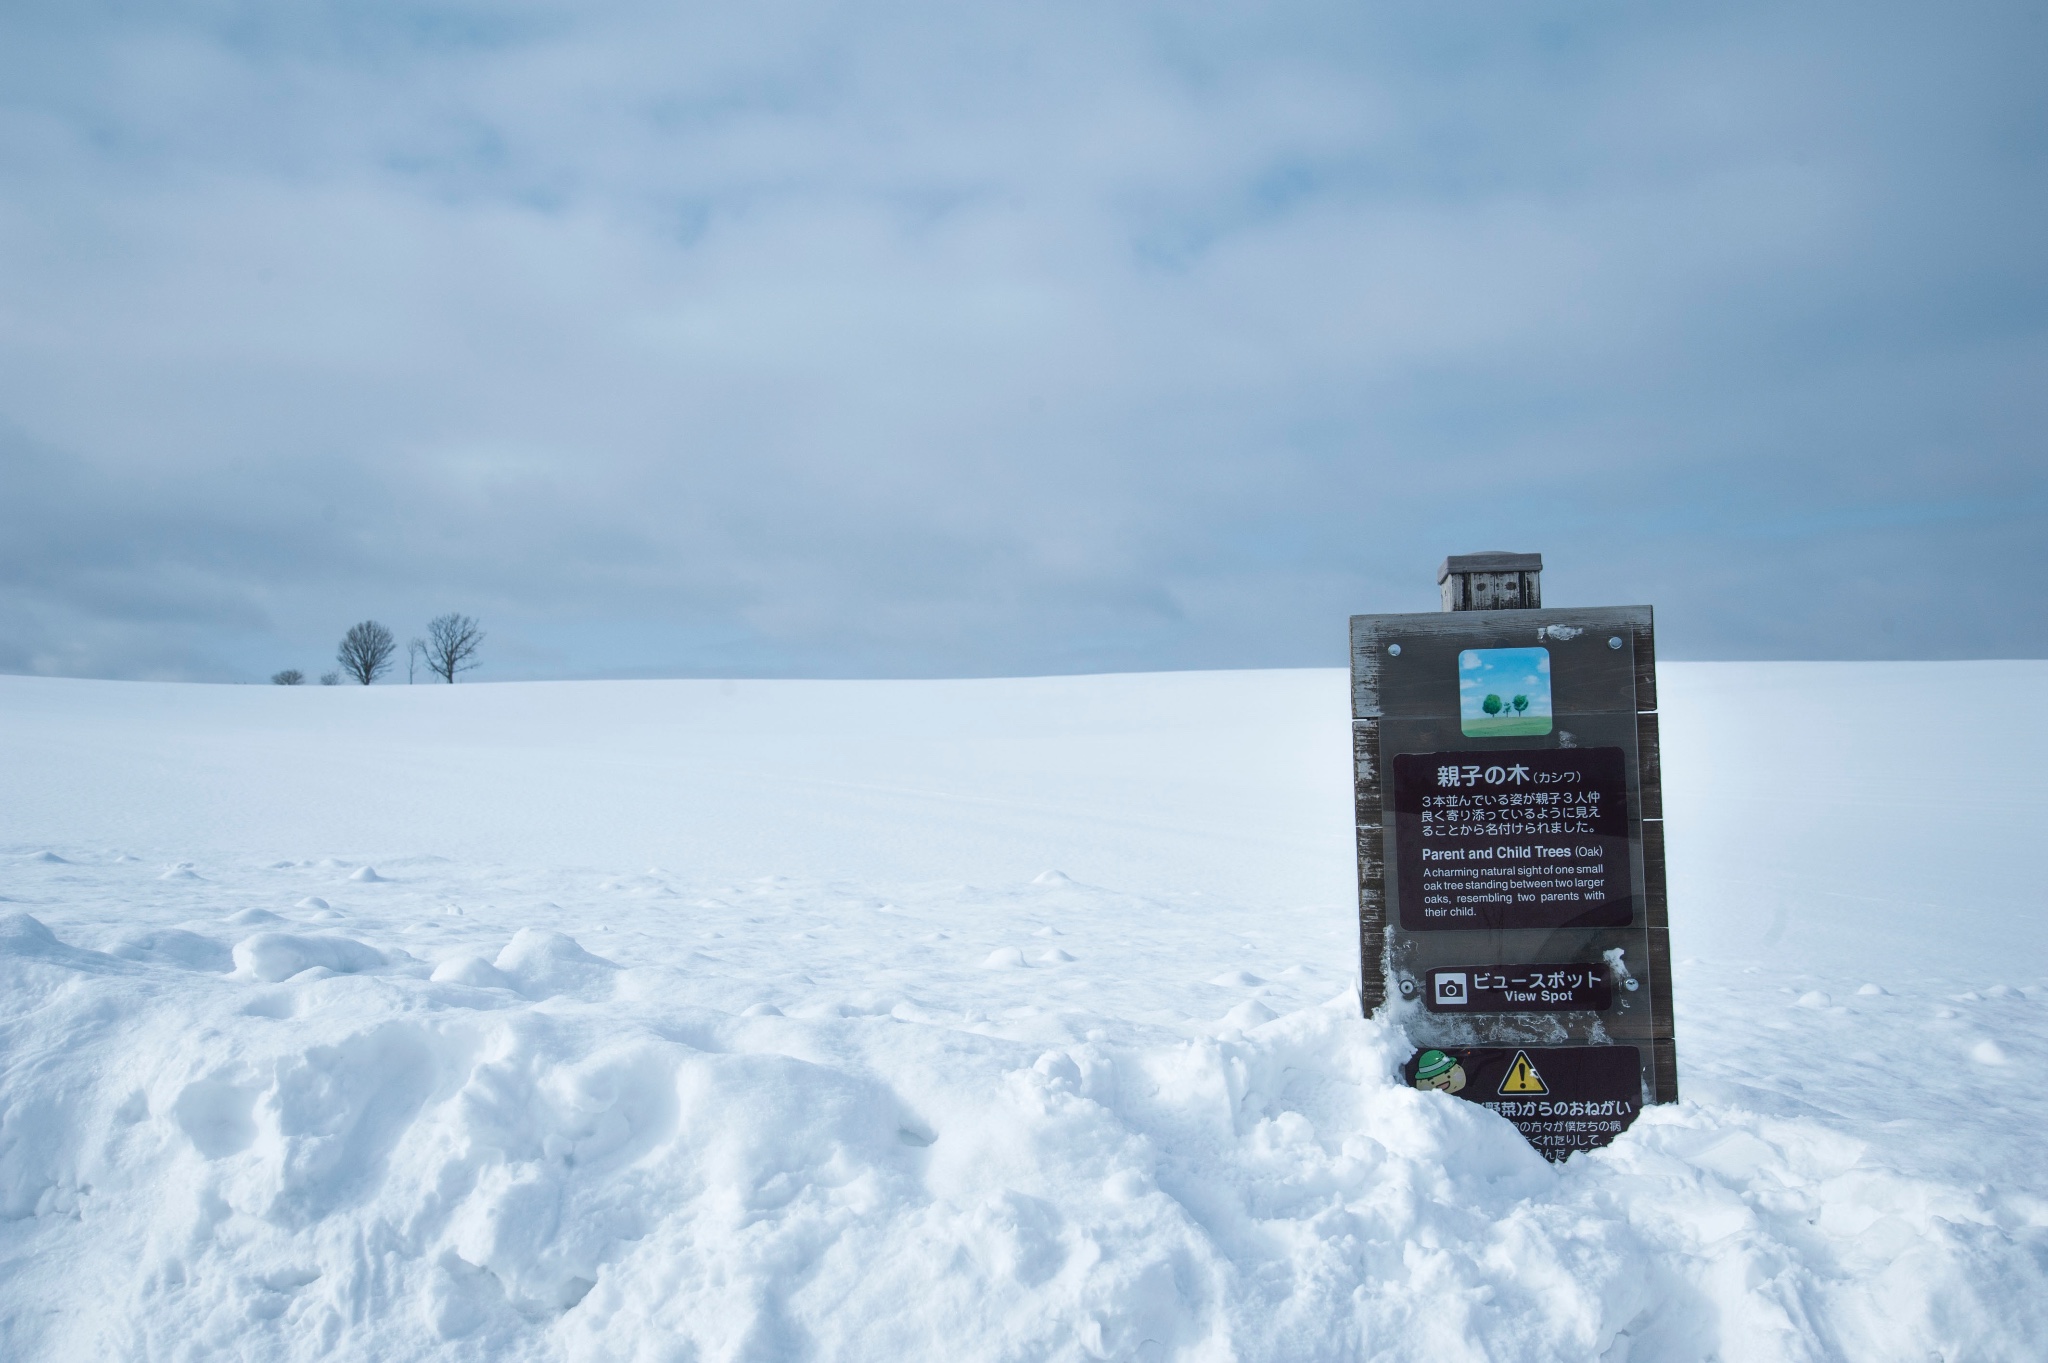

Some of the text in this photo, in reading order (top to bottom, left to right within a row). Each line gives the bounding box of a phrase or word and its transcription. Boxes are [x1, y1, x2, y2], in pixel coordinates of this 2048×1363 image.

[1437, 763, 1530, 788] 親子の木
[1421, 806, 1601, 823] 良く寄り添っているように見え
[1422, 821, 1595, 837] ることから名付けられました。
[1422, 845, 1603, 860] Parent and Child Trees (Oak)
[1423, 864, 1604, 878] A charming natural sight of one small
[1423, 878, 1605, 891] oak tree standing between two larger
[1424, 891, 1605, 904] oaks, resembling two parents with
[1425, 907, 1477, 917] their child.
[1473, 971, 1602, 990] ビュースポット
[1504, 990, 1573, 1003] View Spot
